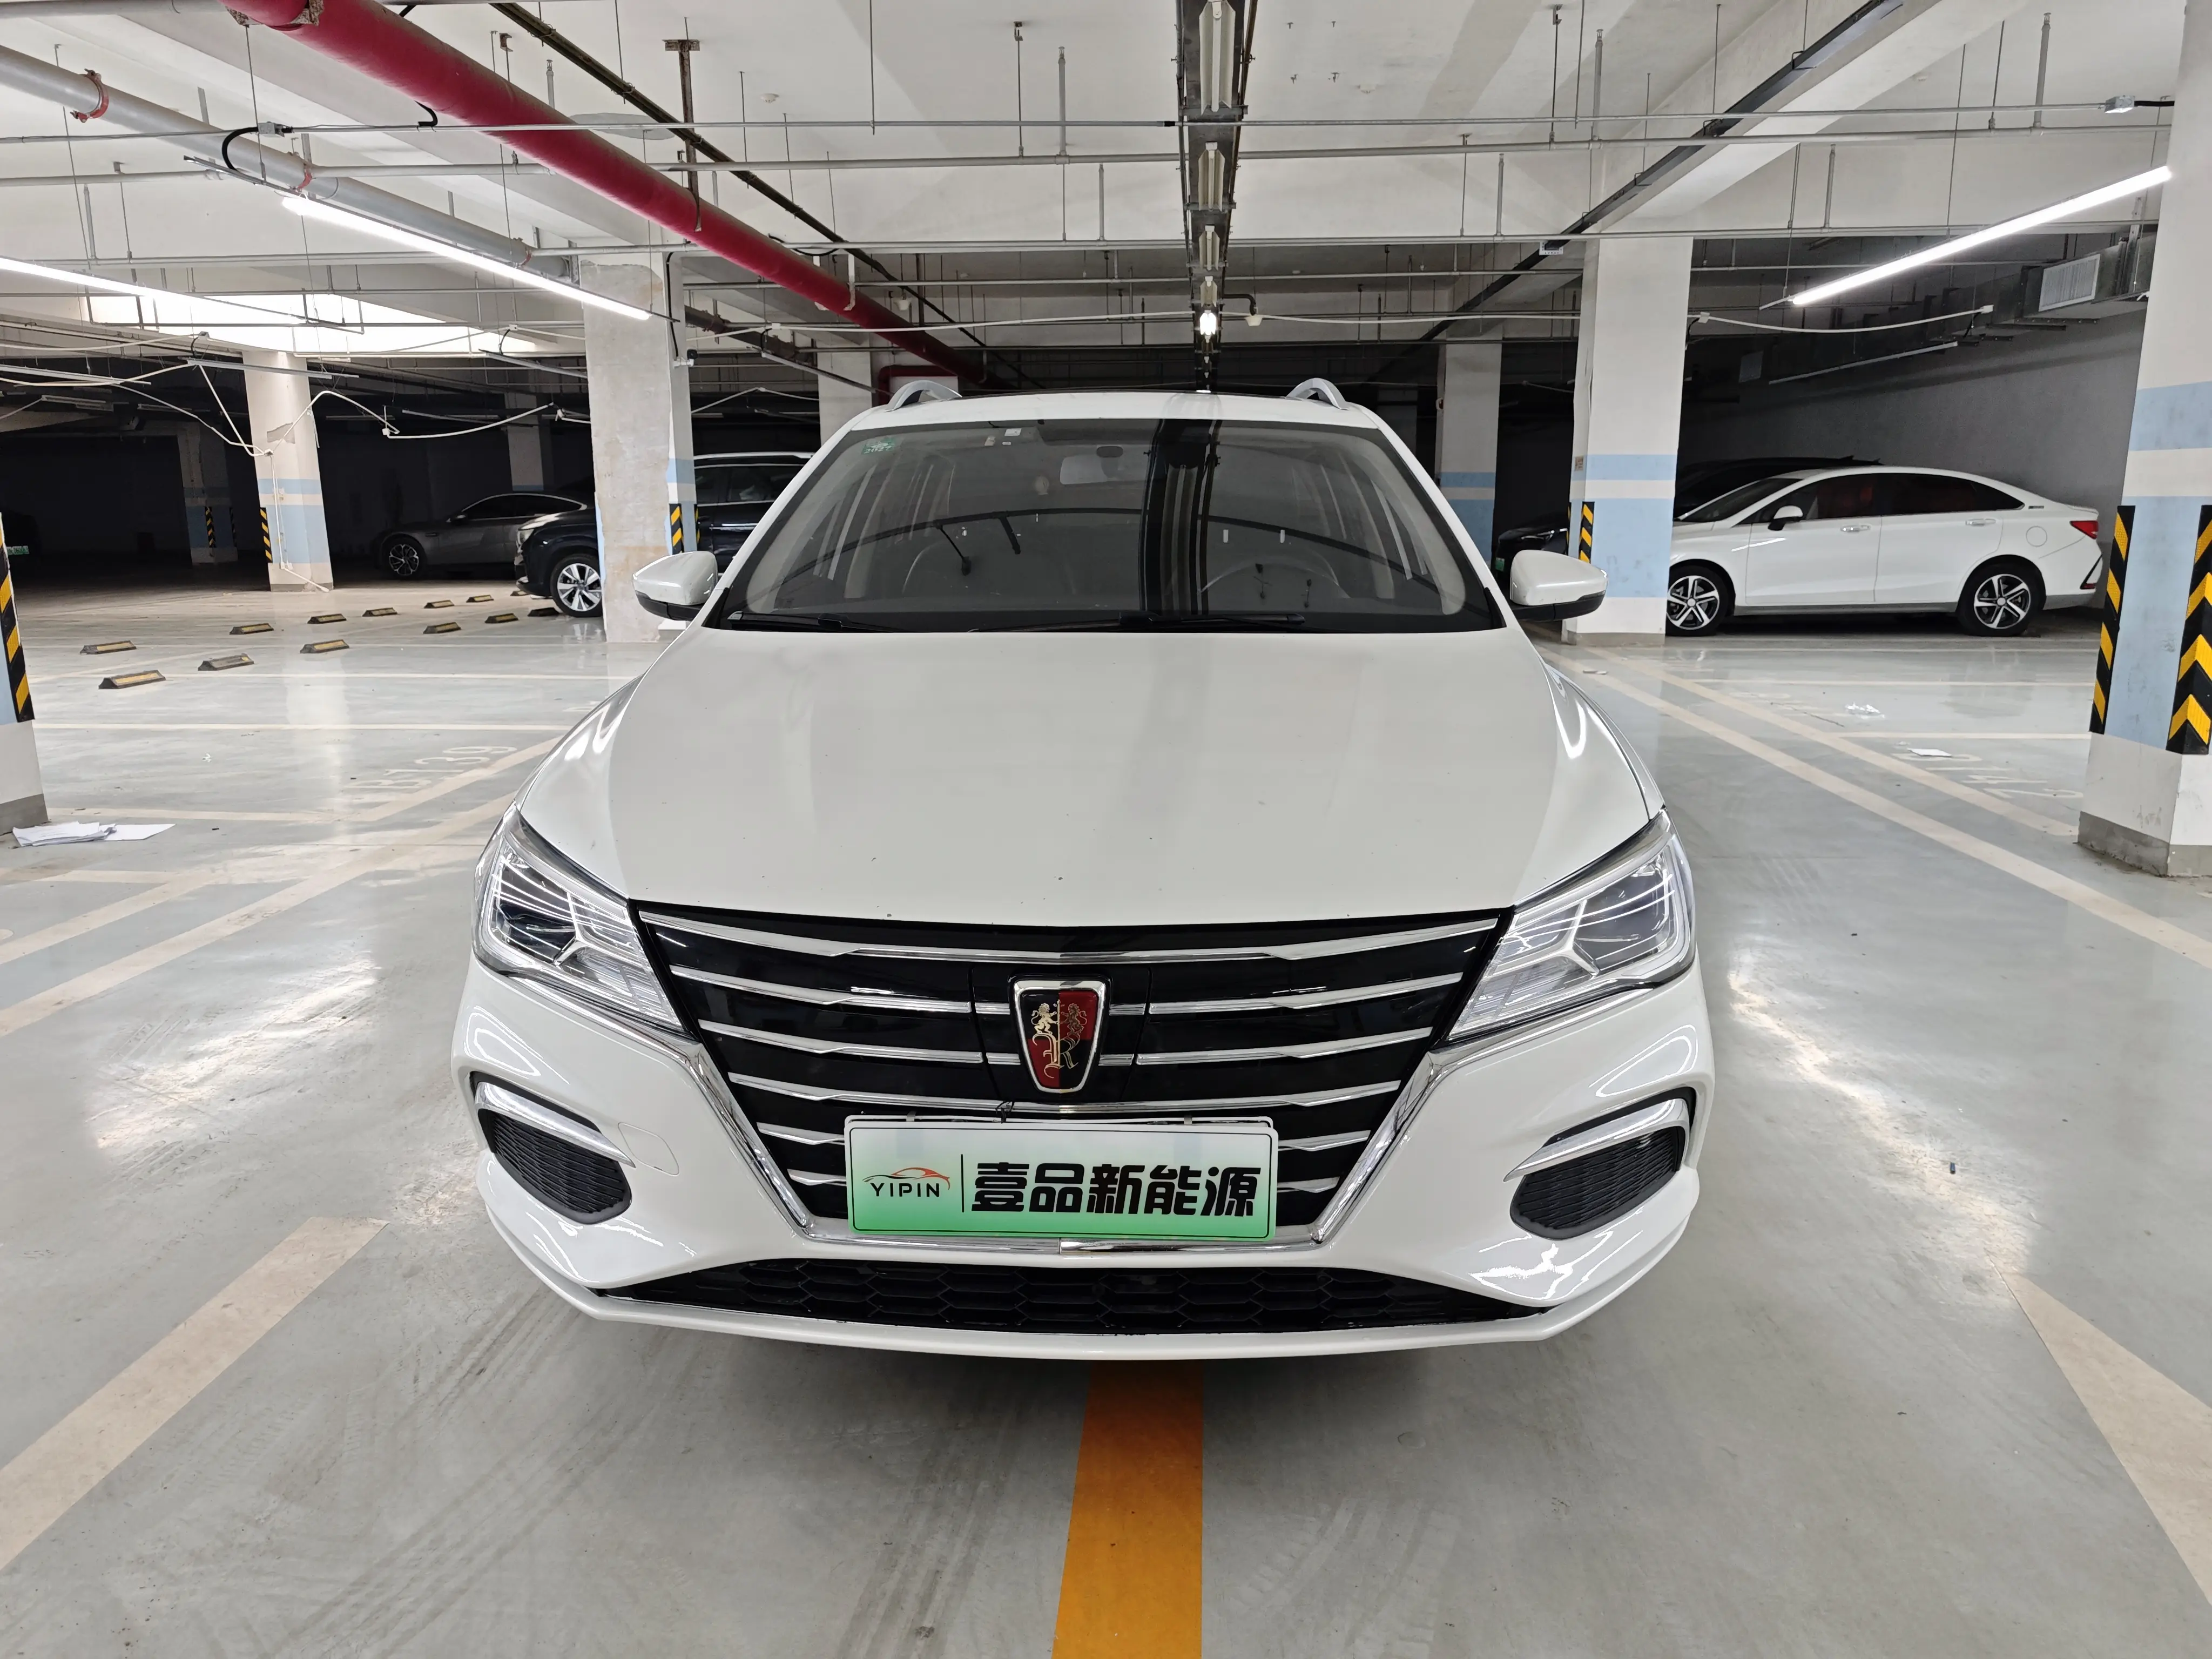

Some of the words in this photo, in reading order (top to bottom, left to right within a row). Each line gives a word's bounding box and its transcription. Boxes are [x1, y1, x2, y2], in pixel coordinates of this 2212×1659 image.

[870, 1182, 940, 1198] YIPIN
[972, 1162, 1262, 1217] 壹品新能源
